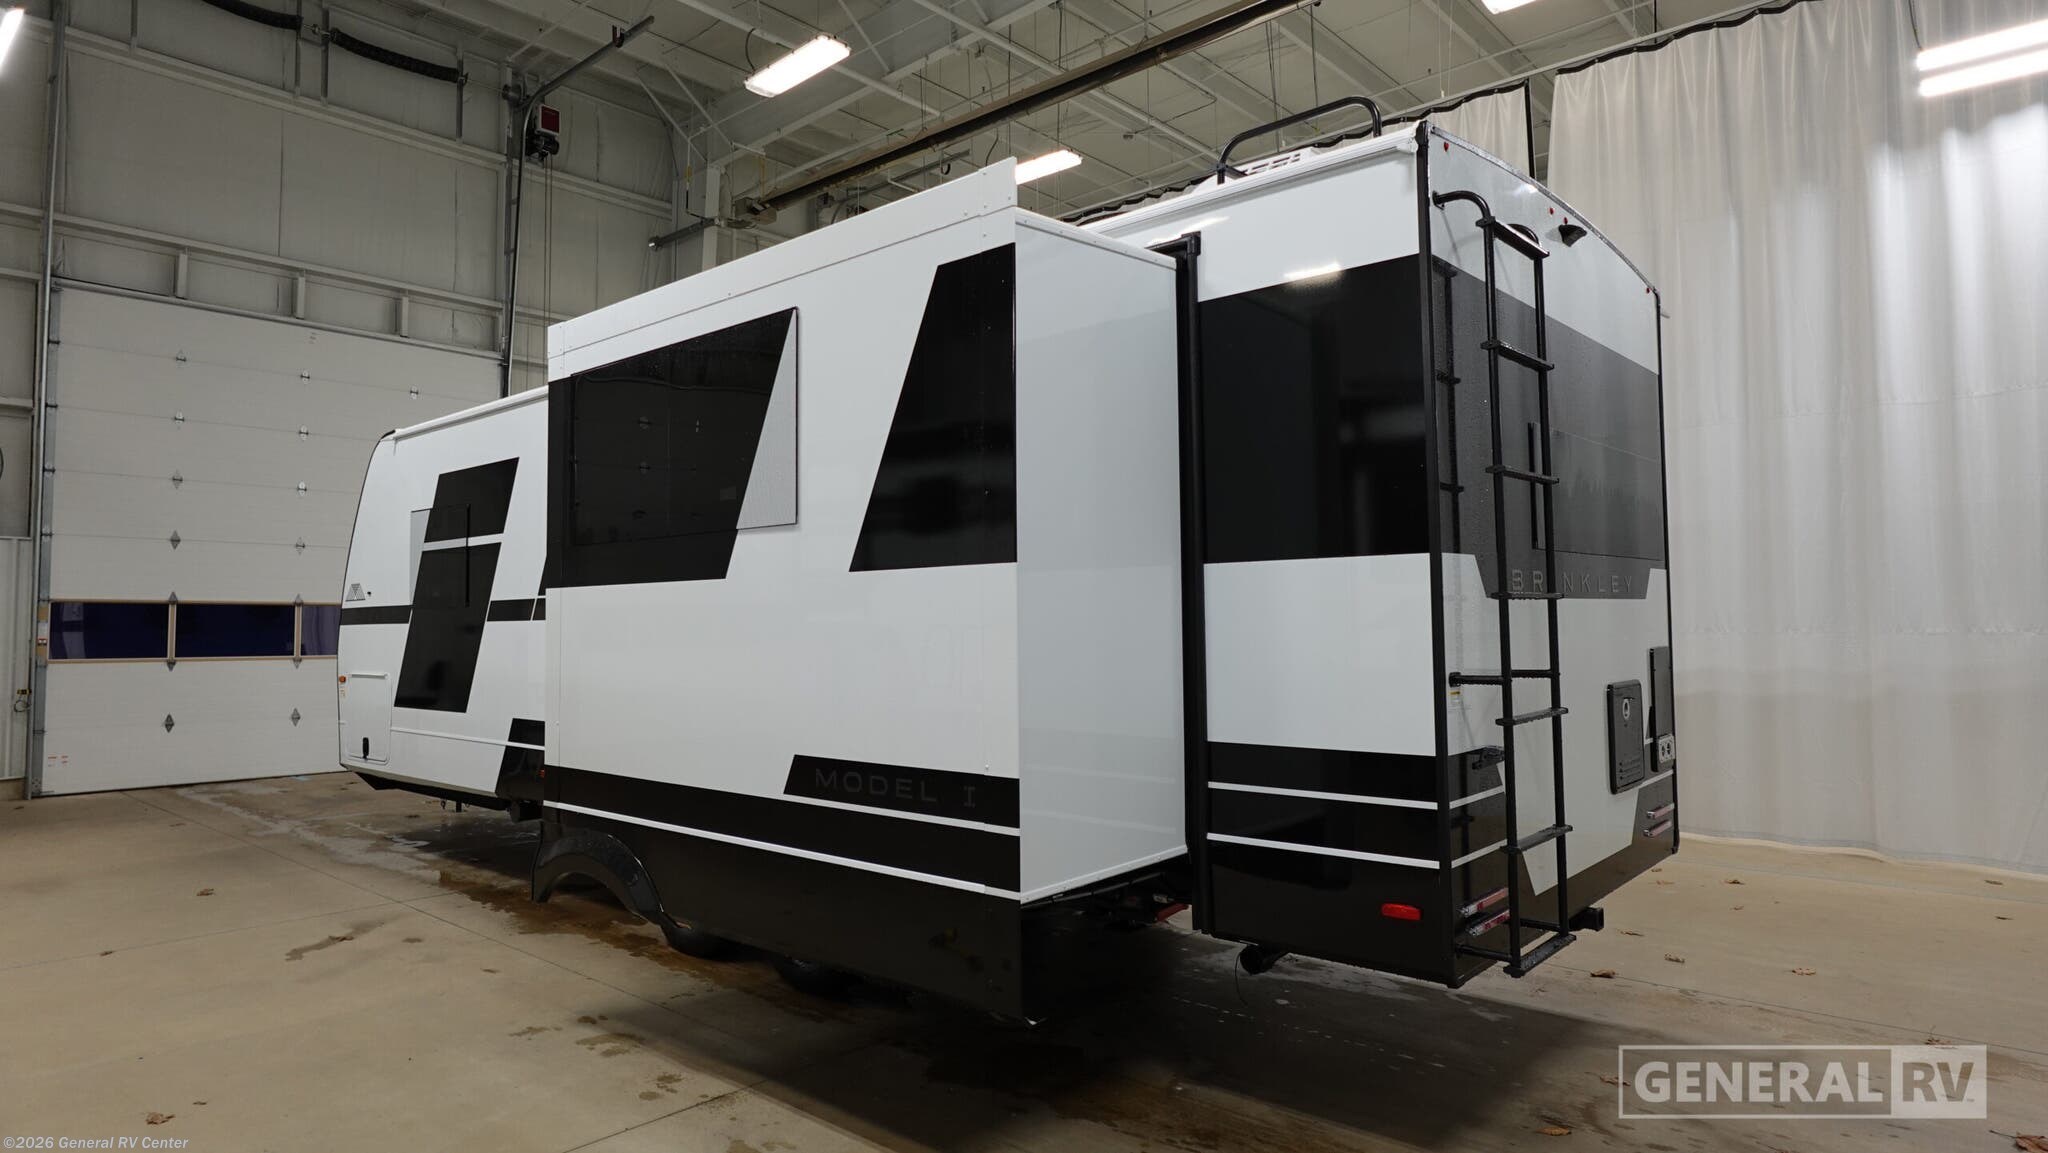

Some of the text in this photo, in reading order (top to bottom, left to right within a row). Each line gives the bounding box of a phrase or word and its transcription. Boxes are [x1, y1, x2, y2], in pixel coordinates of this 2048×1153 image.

[1511, 568, 1633, 594] BRNKLEY
[814, 768, 976, 808] MODEL I
